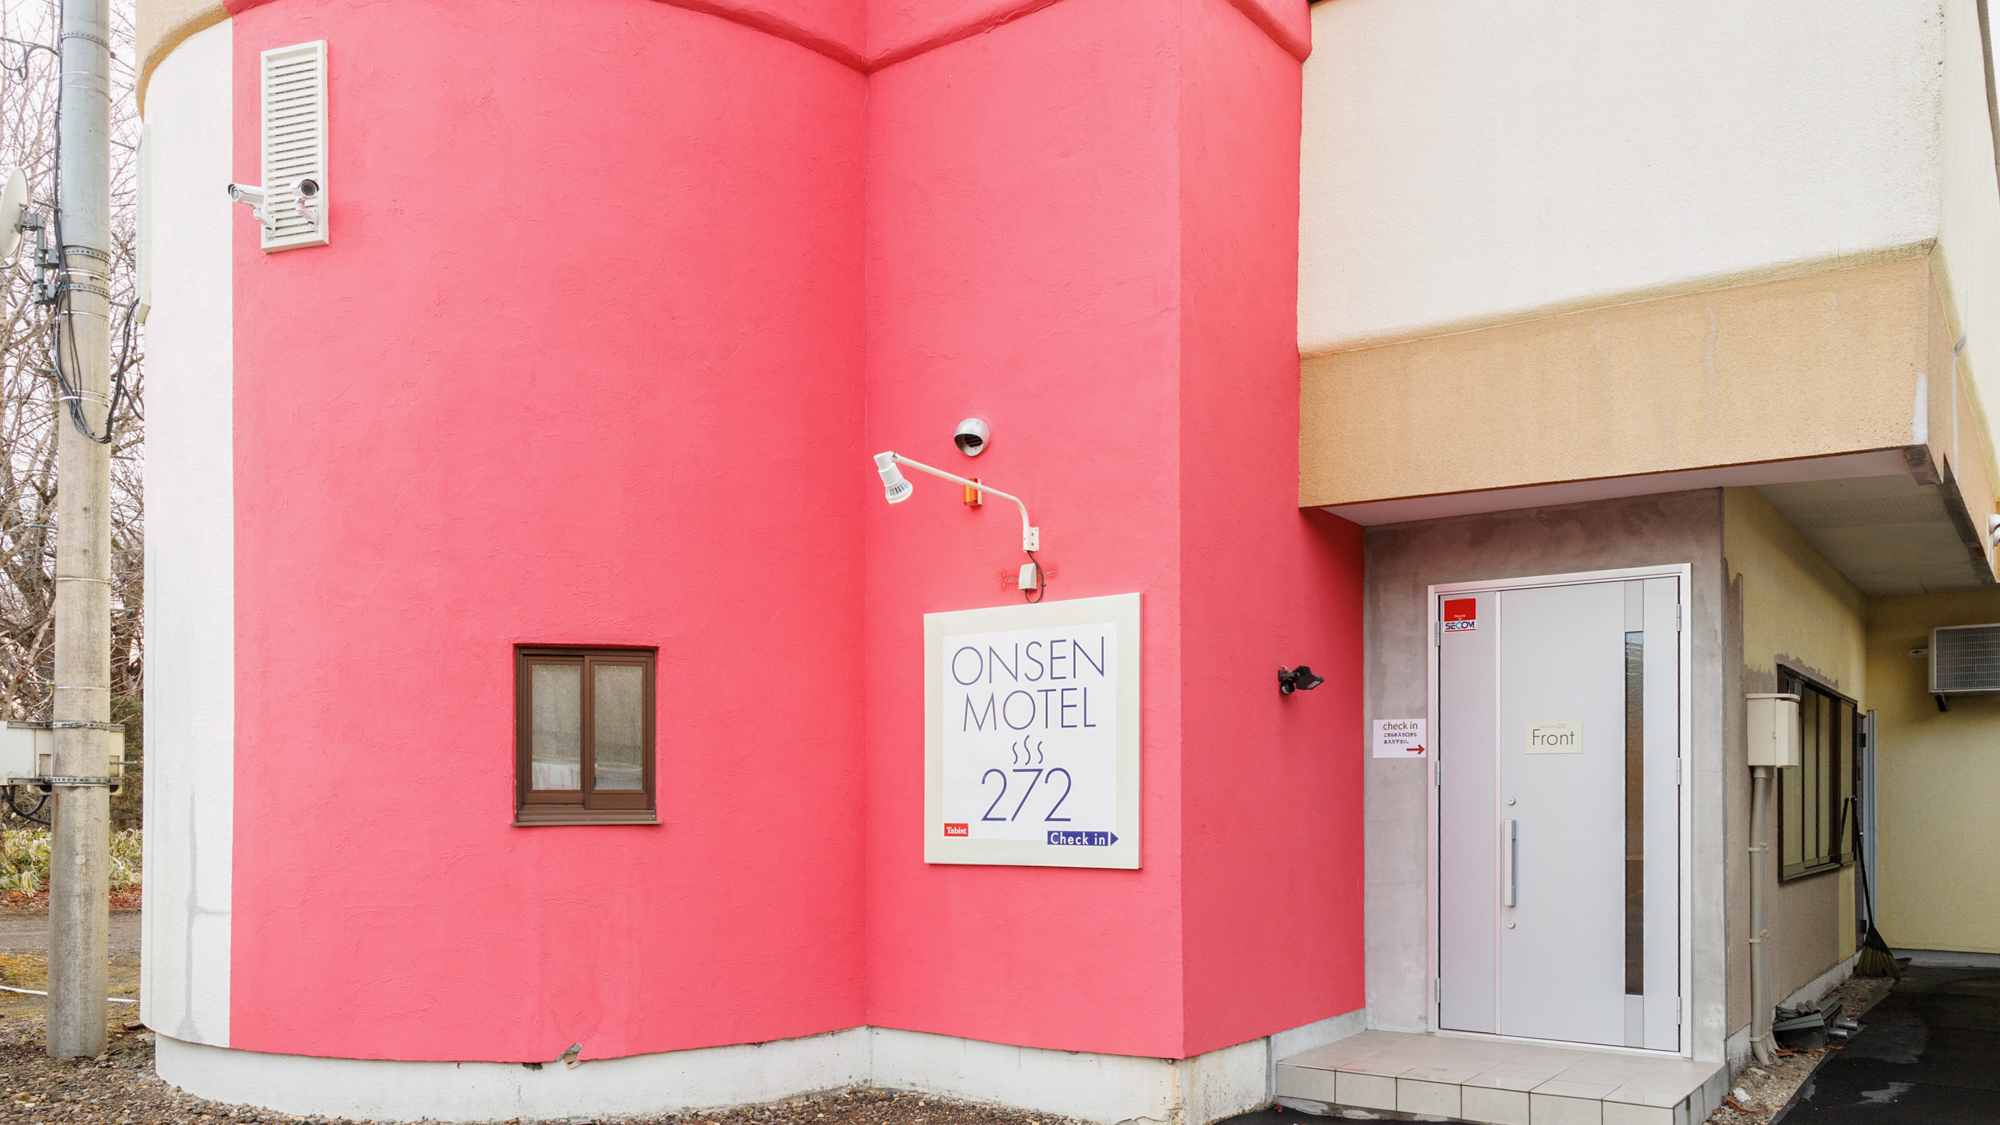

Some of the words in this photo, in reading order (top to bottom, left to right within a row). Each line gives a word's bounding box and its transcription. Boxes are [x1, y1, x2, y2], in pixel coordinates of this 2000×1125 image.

[1445, 621, 1475, 630] SECOM
[952, 636, 1105, 685] ONSEN
[963, 687, 1096, 732] MOTEL
[1382, 721, 1408, 731] check
[1409, 721, 1418, 730] in
[1532, 728, 1575, 746] Front
[981, 767, 1072, 822] 272
[946, 826, 967, 835] Tabist
[1050, 831, 1089, 845] Check
[1094, 833, 1106, 846] in
